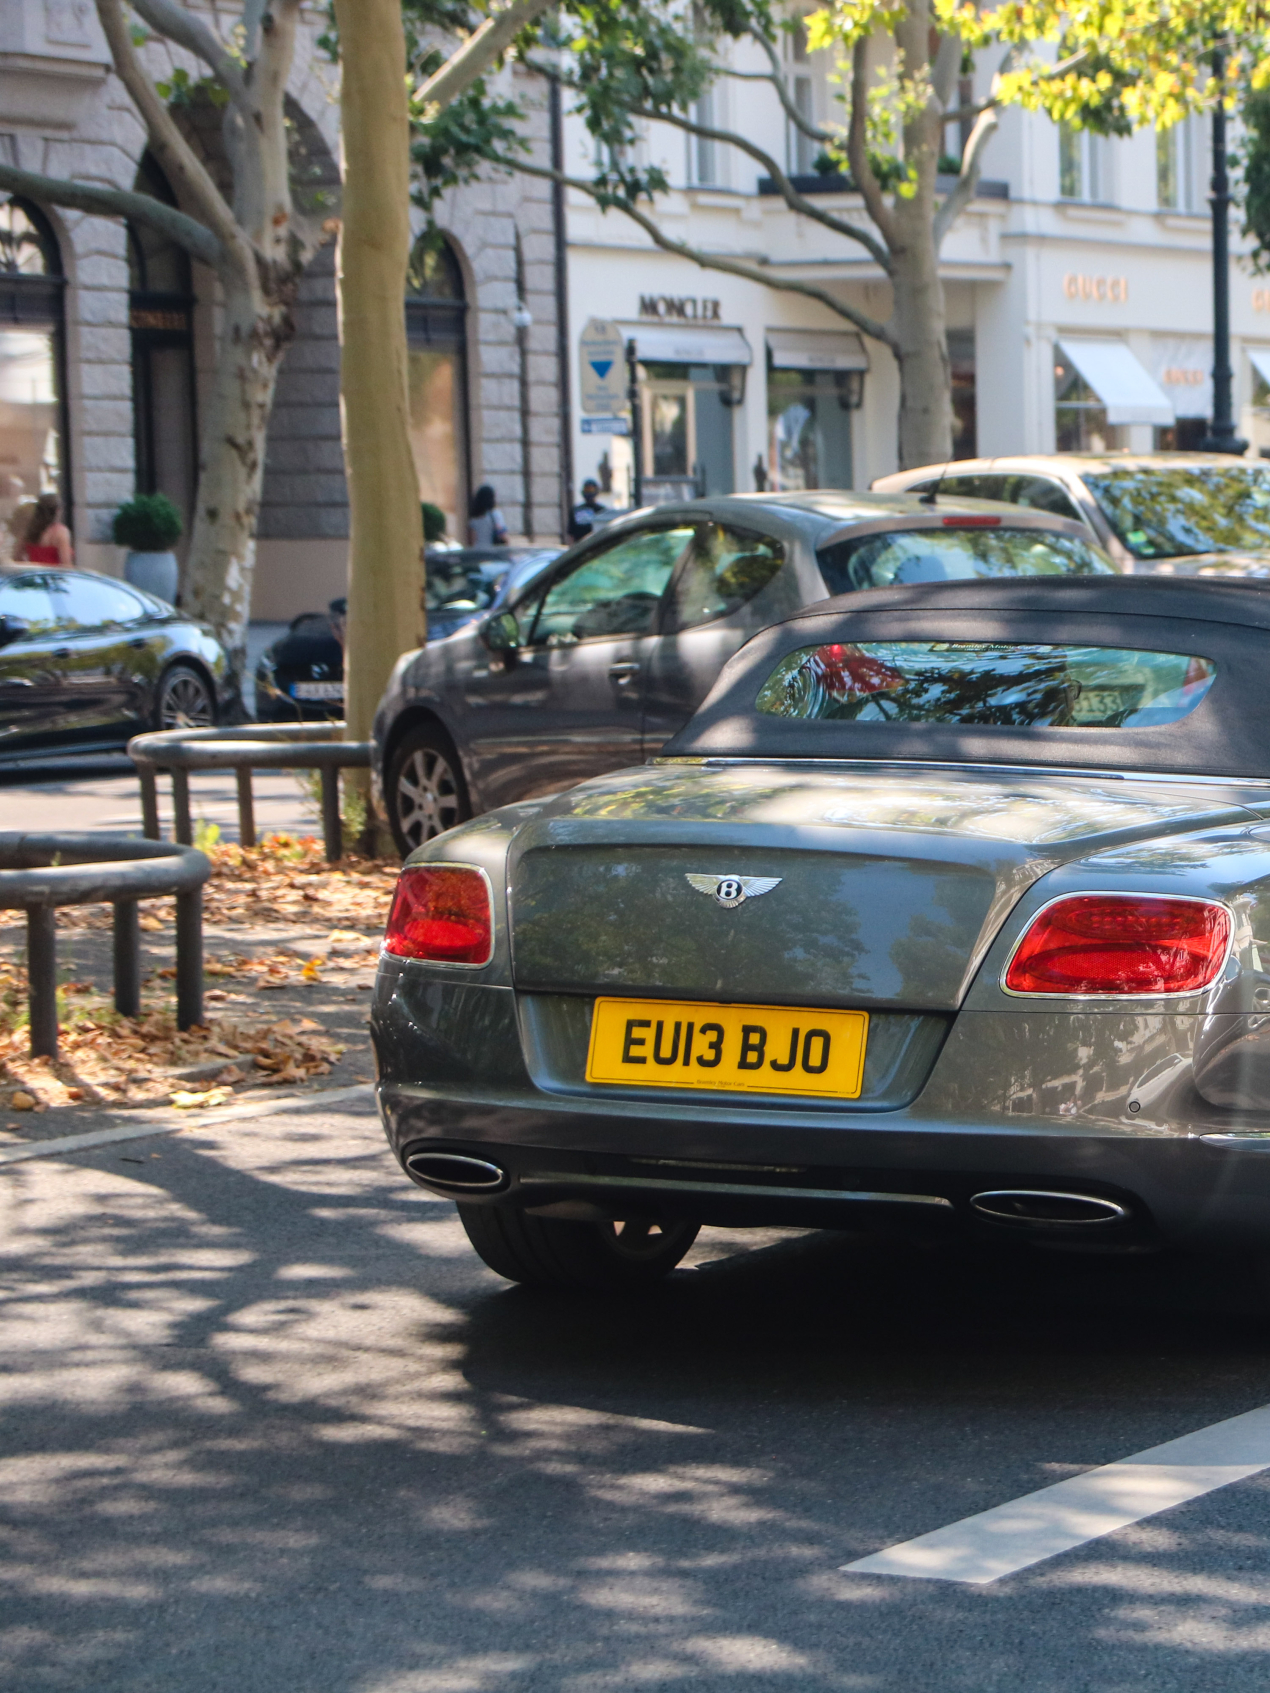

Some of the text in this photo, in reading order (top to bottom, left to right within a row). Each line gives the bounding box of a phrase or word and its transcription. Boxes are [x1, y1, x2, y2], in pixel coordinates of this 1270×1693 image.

[1063, 271, 1128, 303] GUCCI
[639, 294, 721, 321] MONCLER
[621, 1018, 832, 1075] EU13 BJO
